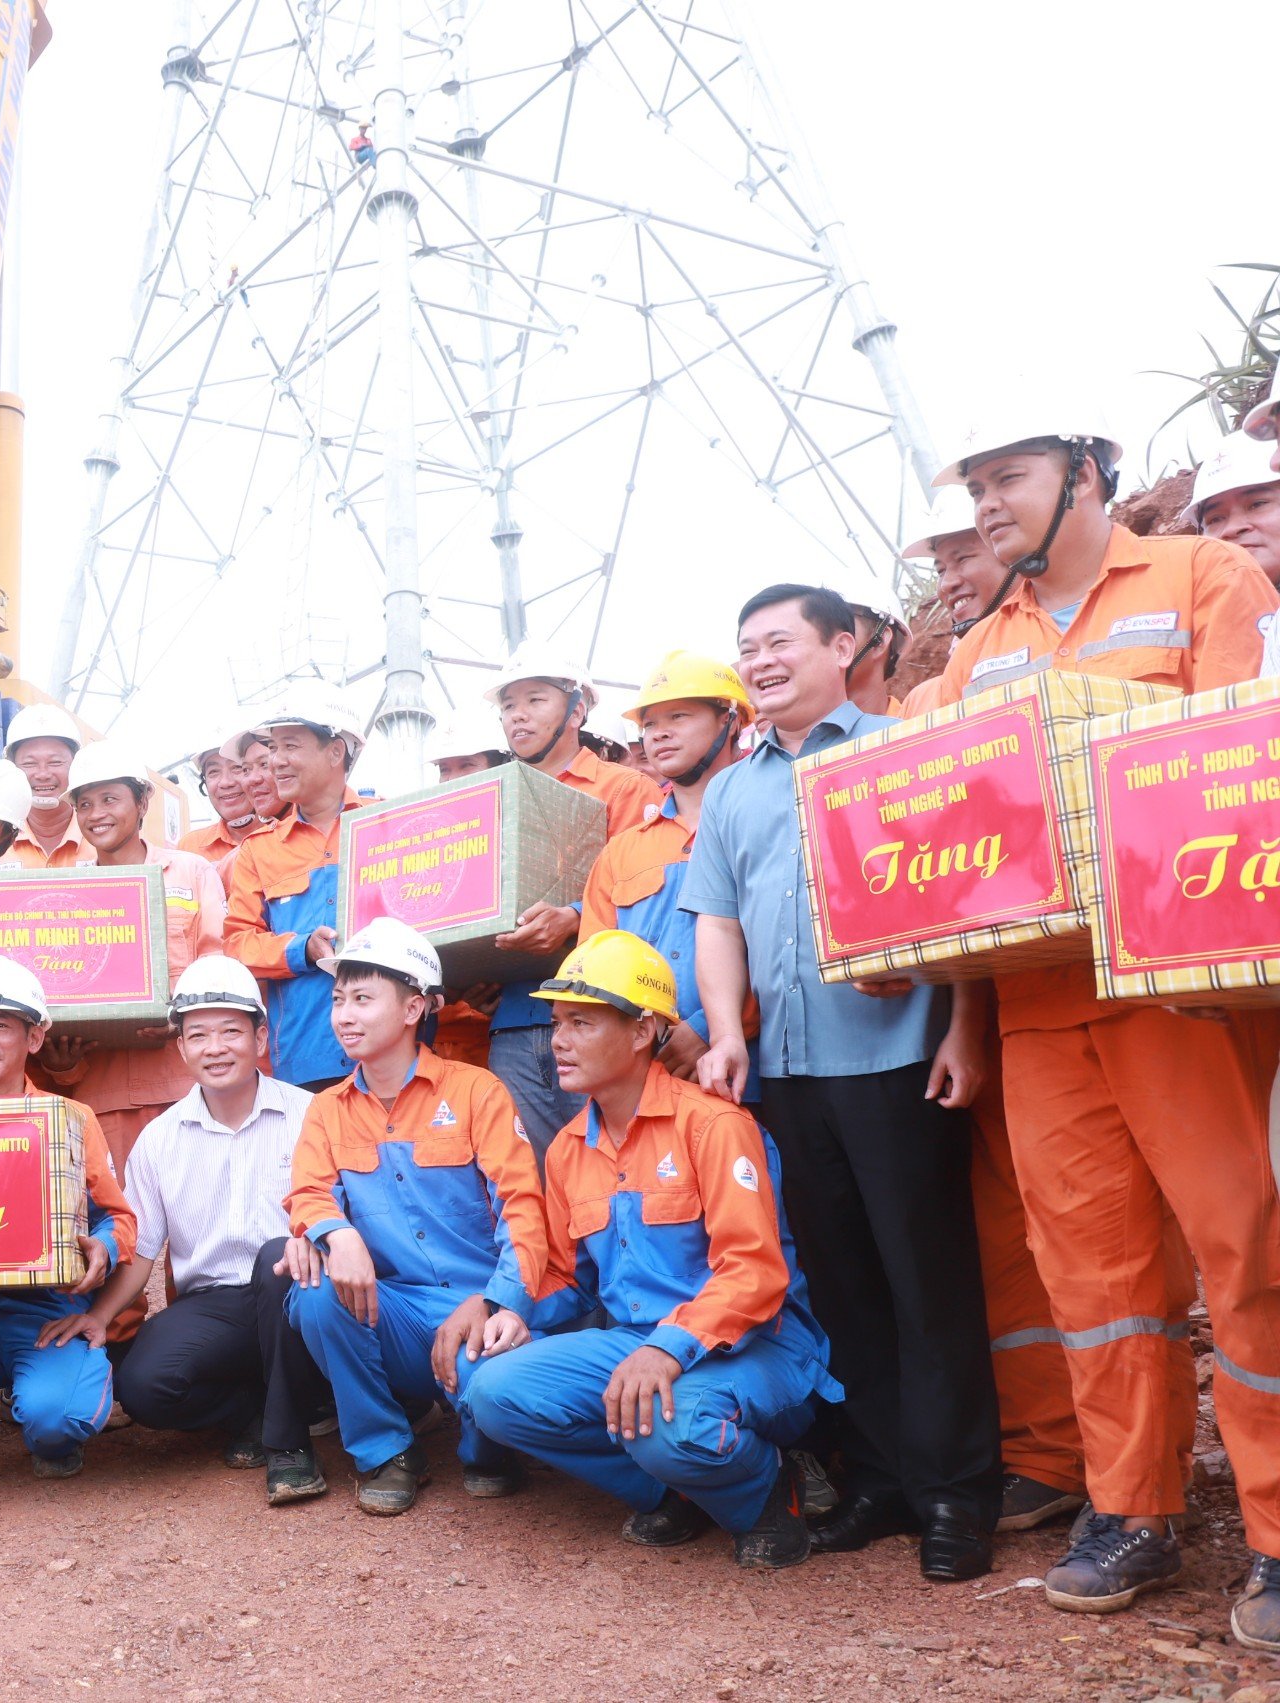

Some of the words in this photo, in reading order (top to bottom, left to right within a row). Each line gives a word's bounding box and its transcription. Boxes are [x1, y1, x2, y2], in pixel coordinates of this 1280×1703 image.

[824, 787, 851, 811] TỈNH
[962, 734, 1020, 768] UBMTTQ
[1124, 761, 1164, 791] TỈNH
[878, 800, 908, 825] TỈNH
[909, 786, 944, 811] NGHỆ
[948, 782, 968, 804] AN
[1202, 781, 1246, 812] TỈNH
[360, 858, 398, 886] PHẠM
[402, 847, 440, 875] MINH
[443, 833, 489, 864] CHÍNH
[862, 833, 1009, 894] Tặng
[400, 881, 442, 902] Tặng
[35, 927, 80, 947] MINH
[84, 922, 136, 945] CHÍNH
[33, 955, 84, 973] Tặng
[636, 973, 661, 991] SÔNG
